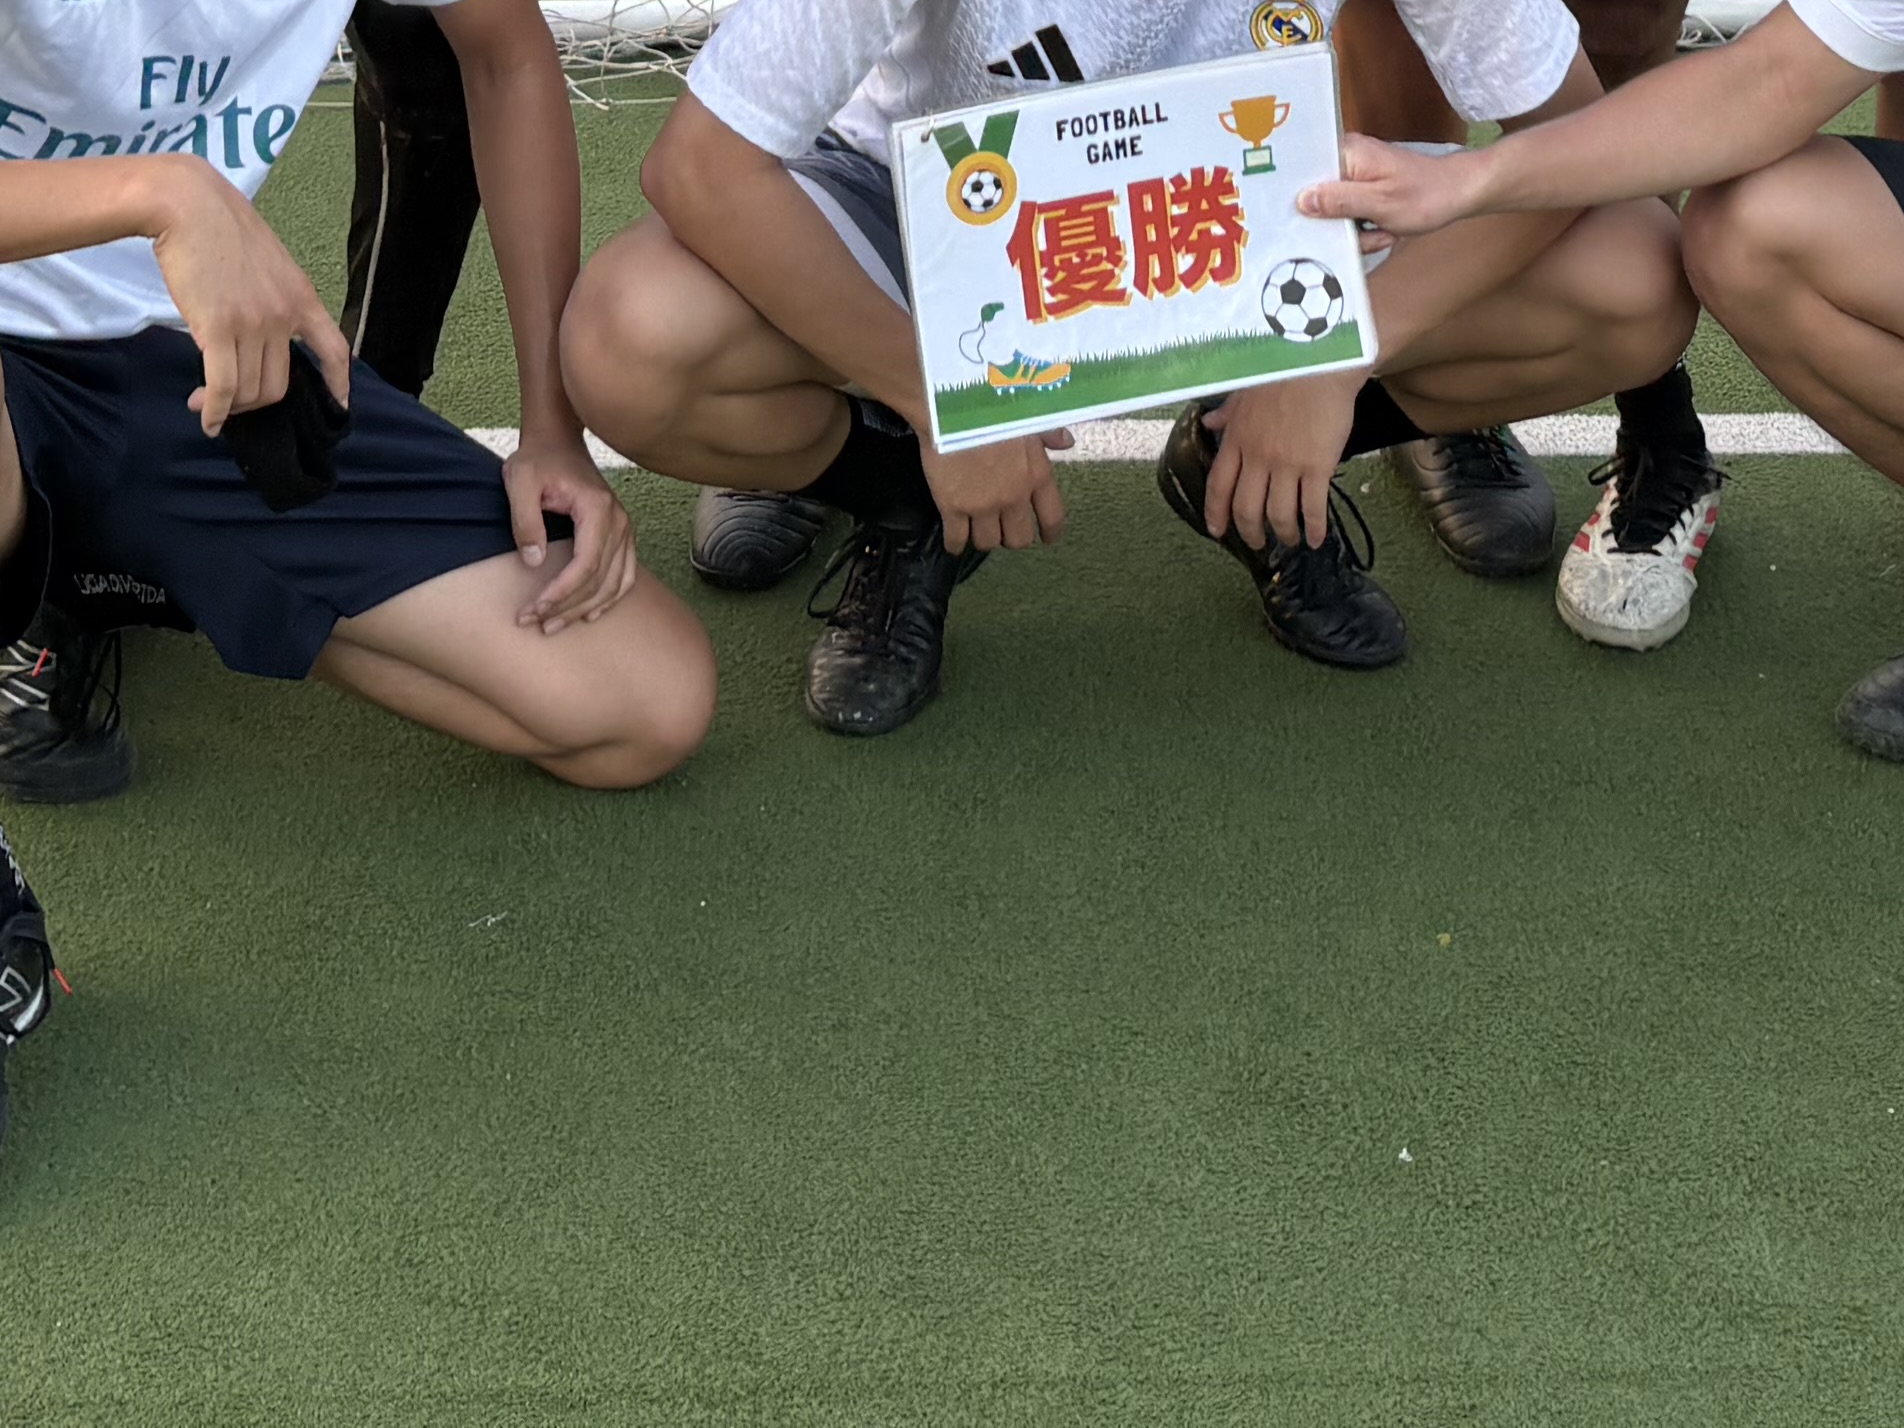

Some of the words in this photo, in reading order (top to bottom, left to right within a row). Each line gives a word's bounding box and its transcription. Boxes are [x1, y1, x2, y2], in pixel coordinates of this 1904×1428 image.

[140, 54, 231, 110] Fly
[1055, 102, 1169, 141] FOOTBALL
[1086, 134, 1144, 165] GAME
[1006, 165, 1249, 325] 優勝
